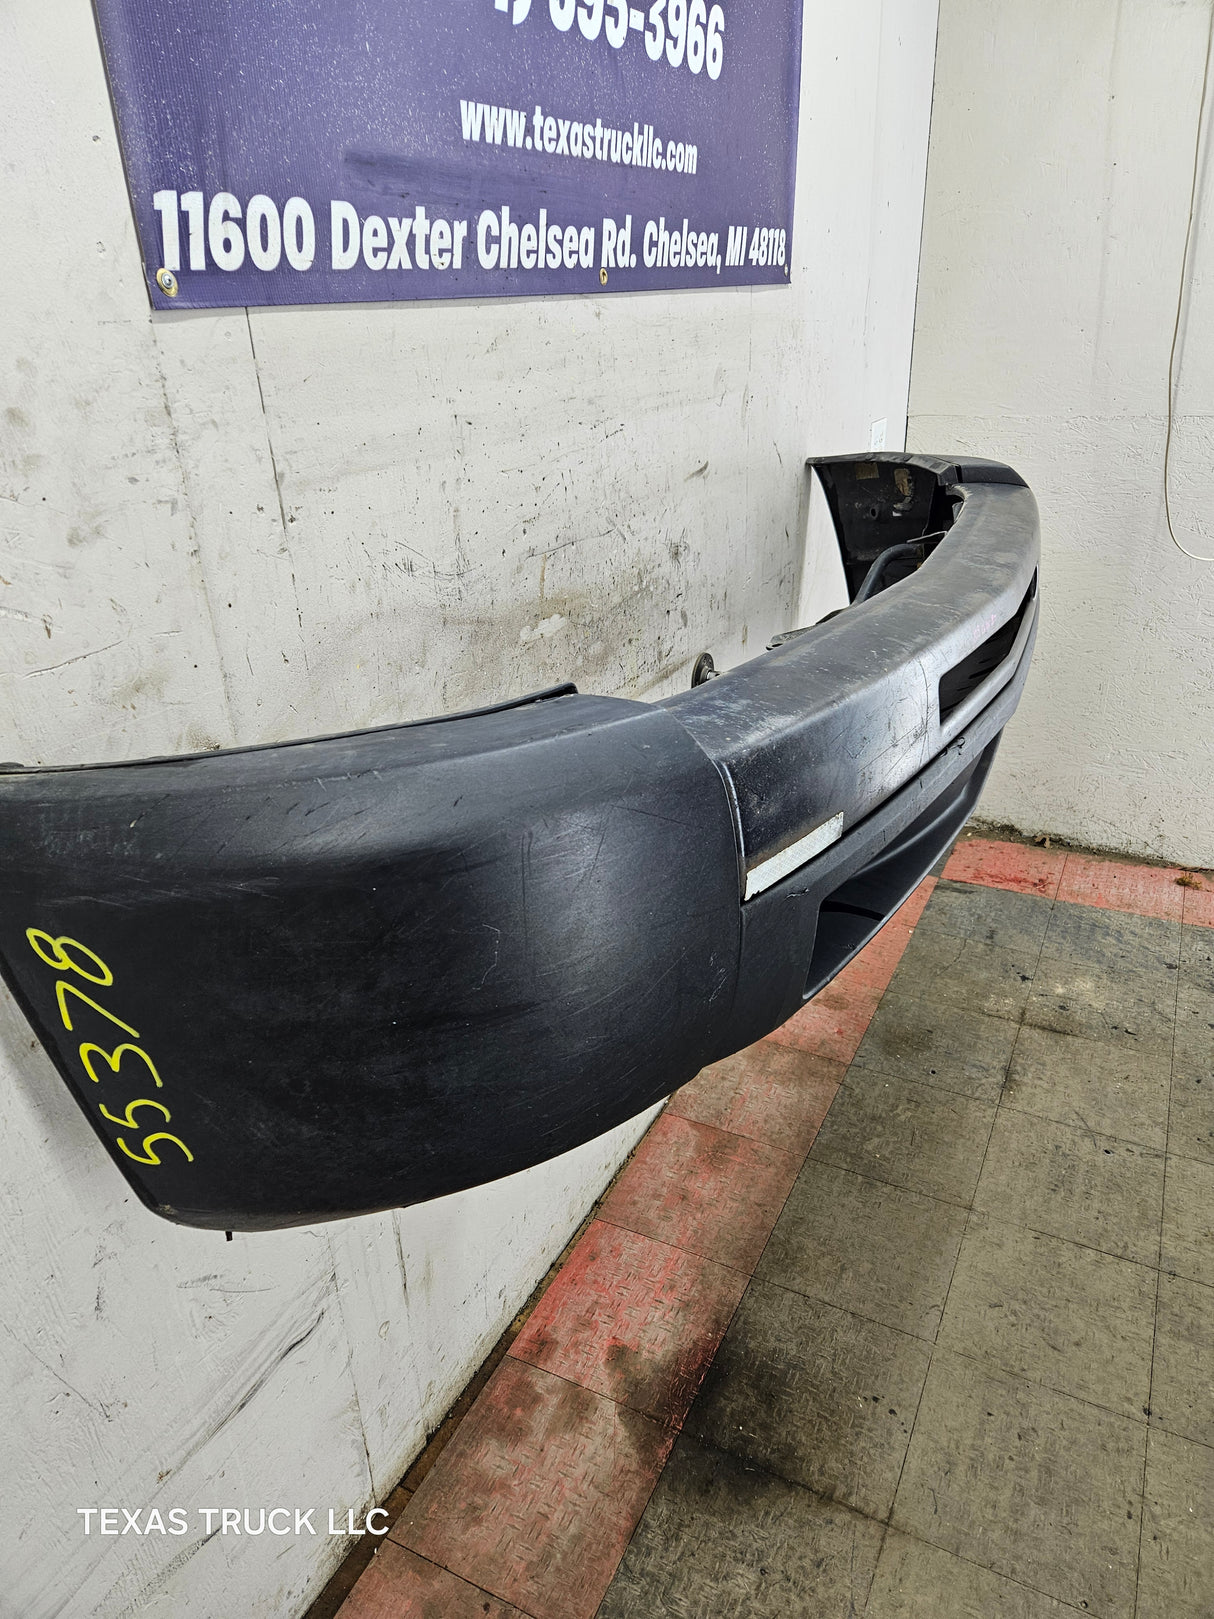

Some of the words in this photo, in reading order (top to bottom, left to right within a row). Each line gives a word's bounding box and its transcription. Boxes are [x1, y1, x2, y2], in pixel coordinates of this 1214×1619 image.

[460, 100, 698, 174] www.texastruckllc.com
[153, 190, 315, 271] 11600
[331, 200, 467, 270] Dexter
[477, 206, 595, 269] Chelsea
[601, 215, 637, 267] Rd.
[643, 217, 721, 274] Chelsea,
[725, 226, 748, 266] MI
[748, 228, 786, 266] 48118
[26, 928, 194, 1165] 55378
